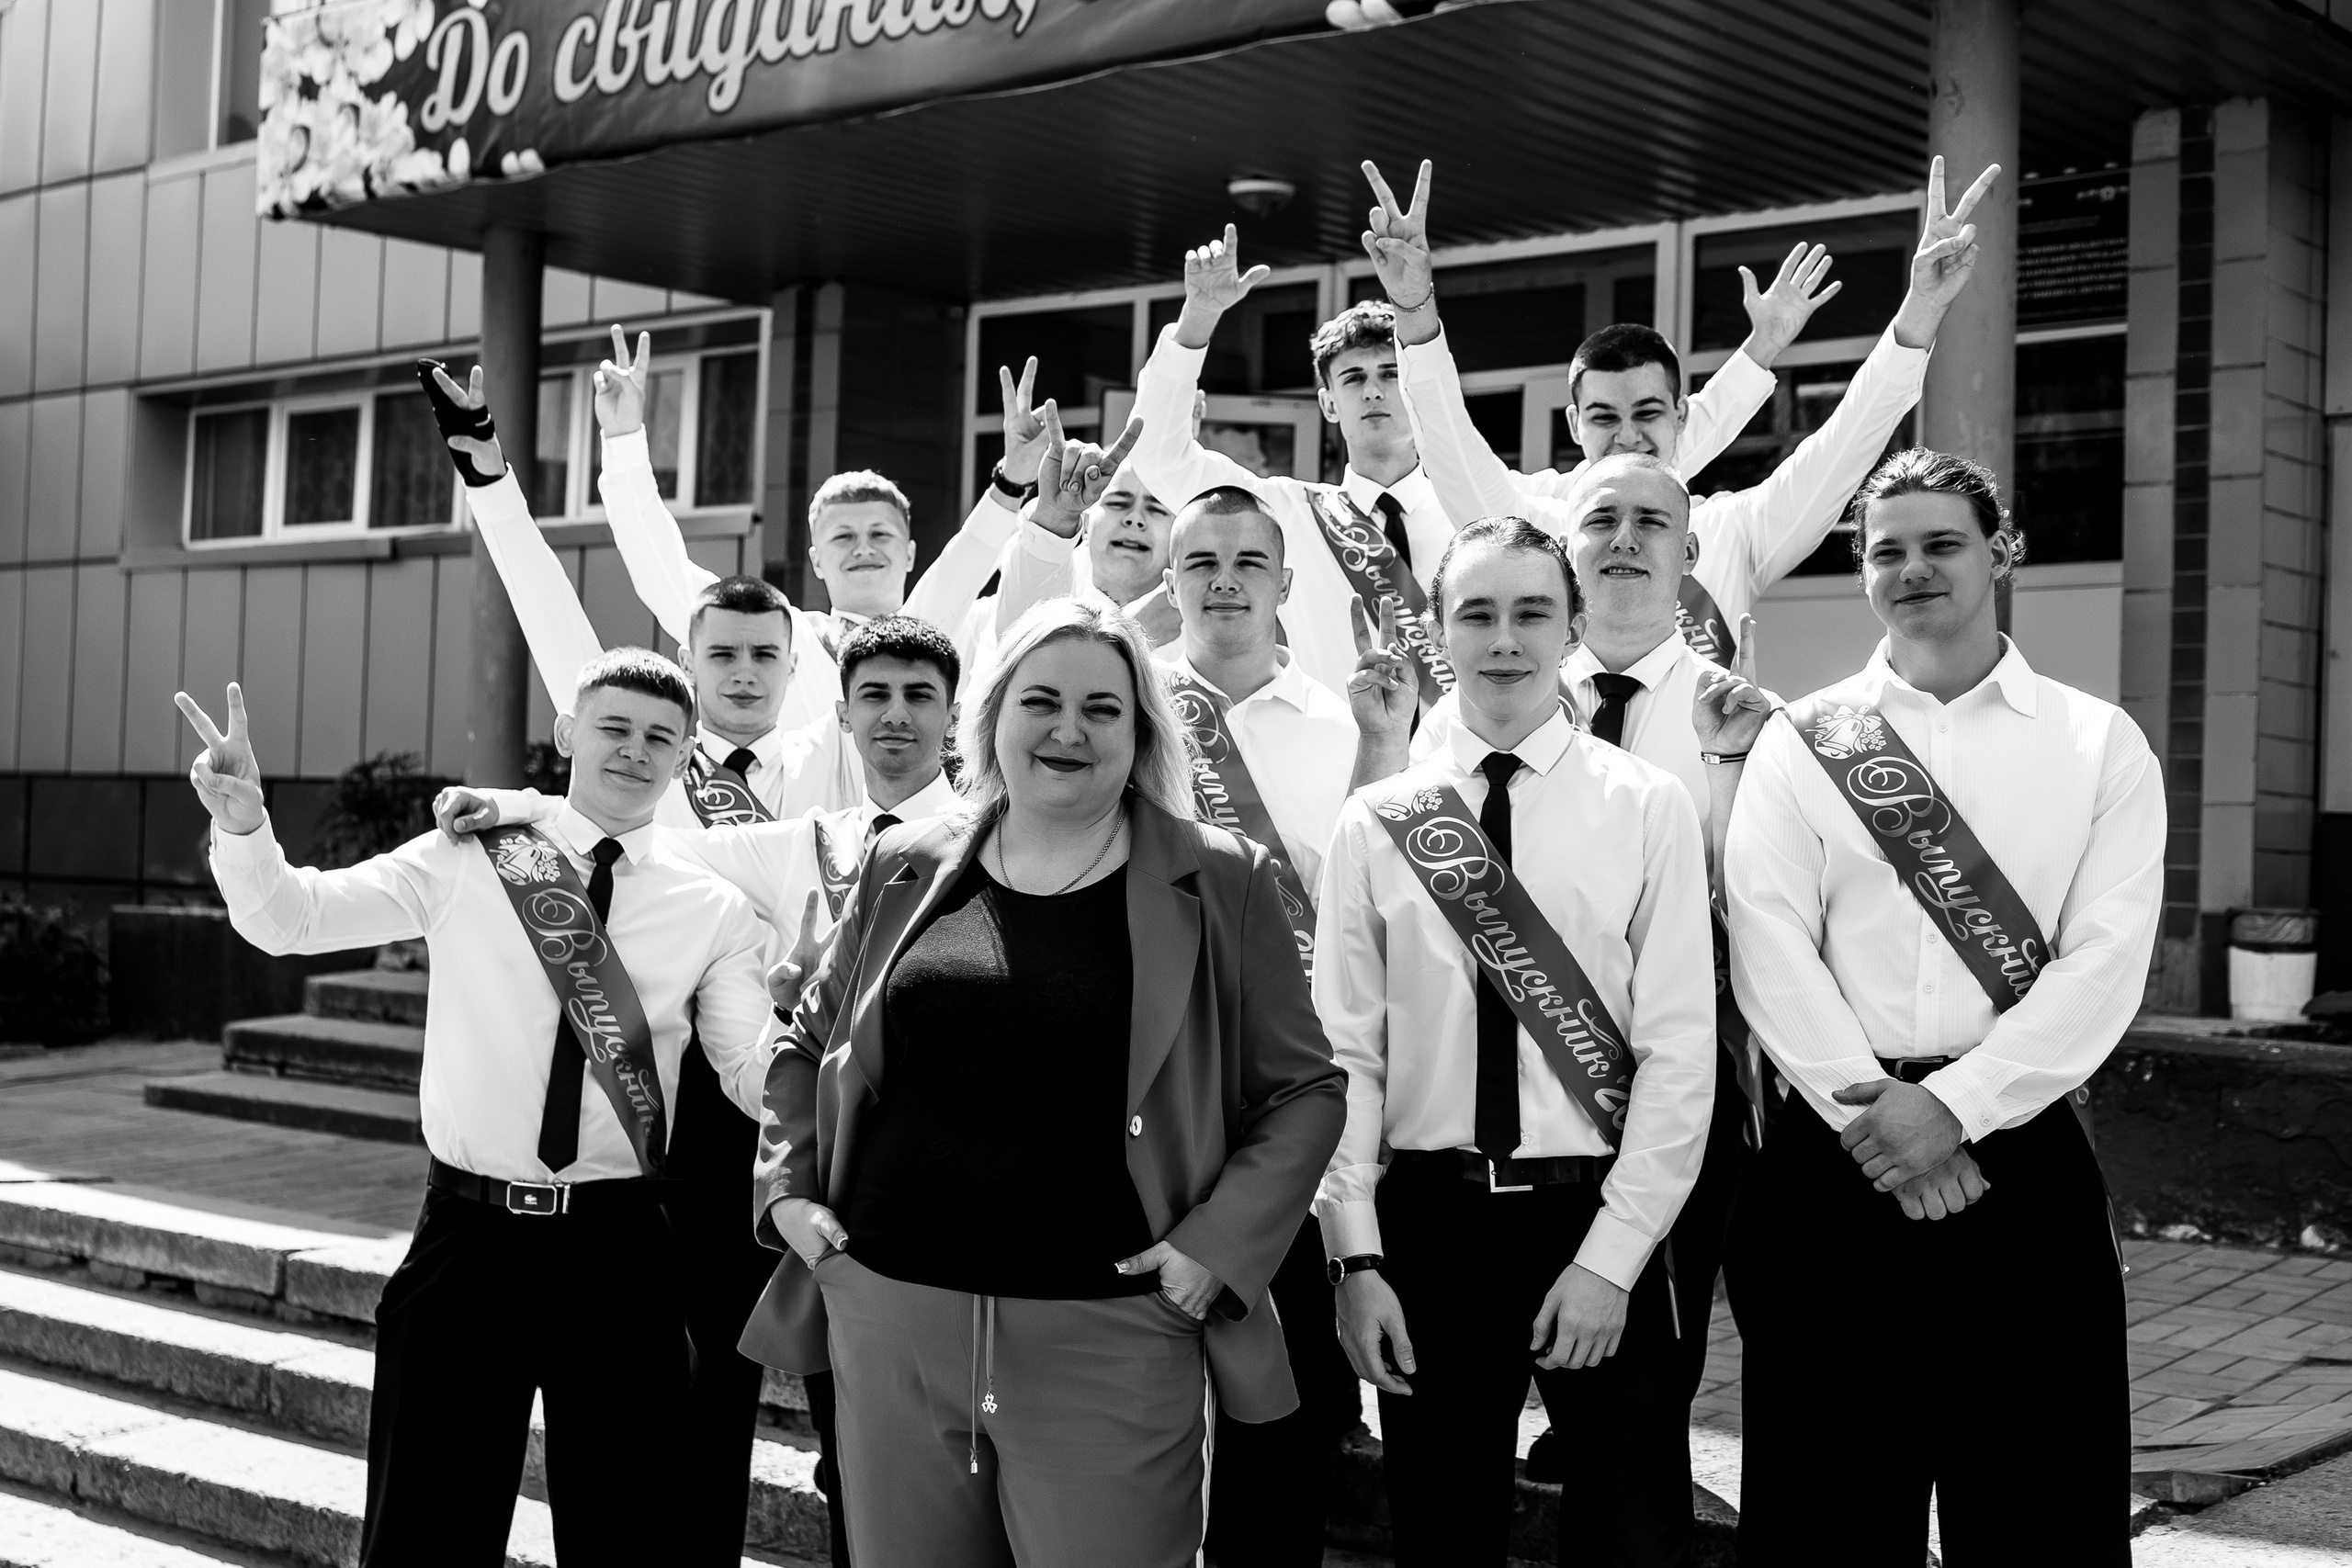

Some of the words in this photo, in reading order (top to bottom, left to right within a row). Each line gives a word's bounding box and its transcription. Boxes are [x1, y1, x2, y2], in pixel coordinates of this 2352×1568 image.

[420, 5, 530, 132] До
[1405, 815, 1623, 1078] Выпускник
[1846, 755, 2039, 1000] Выпускни
[521, 886, 661, 1137] Выпускник
